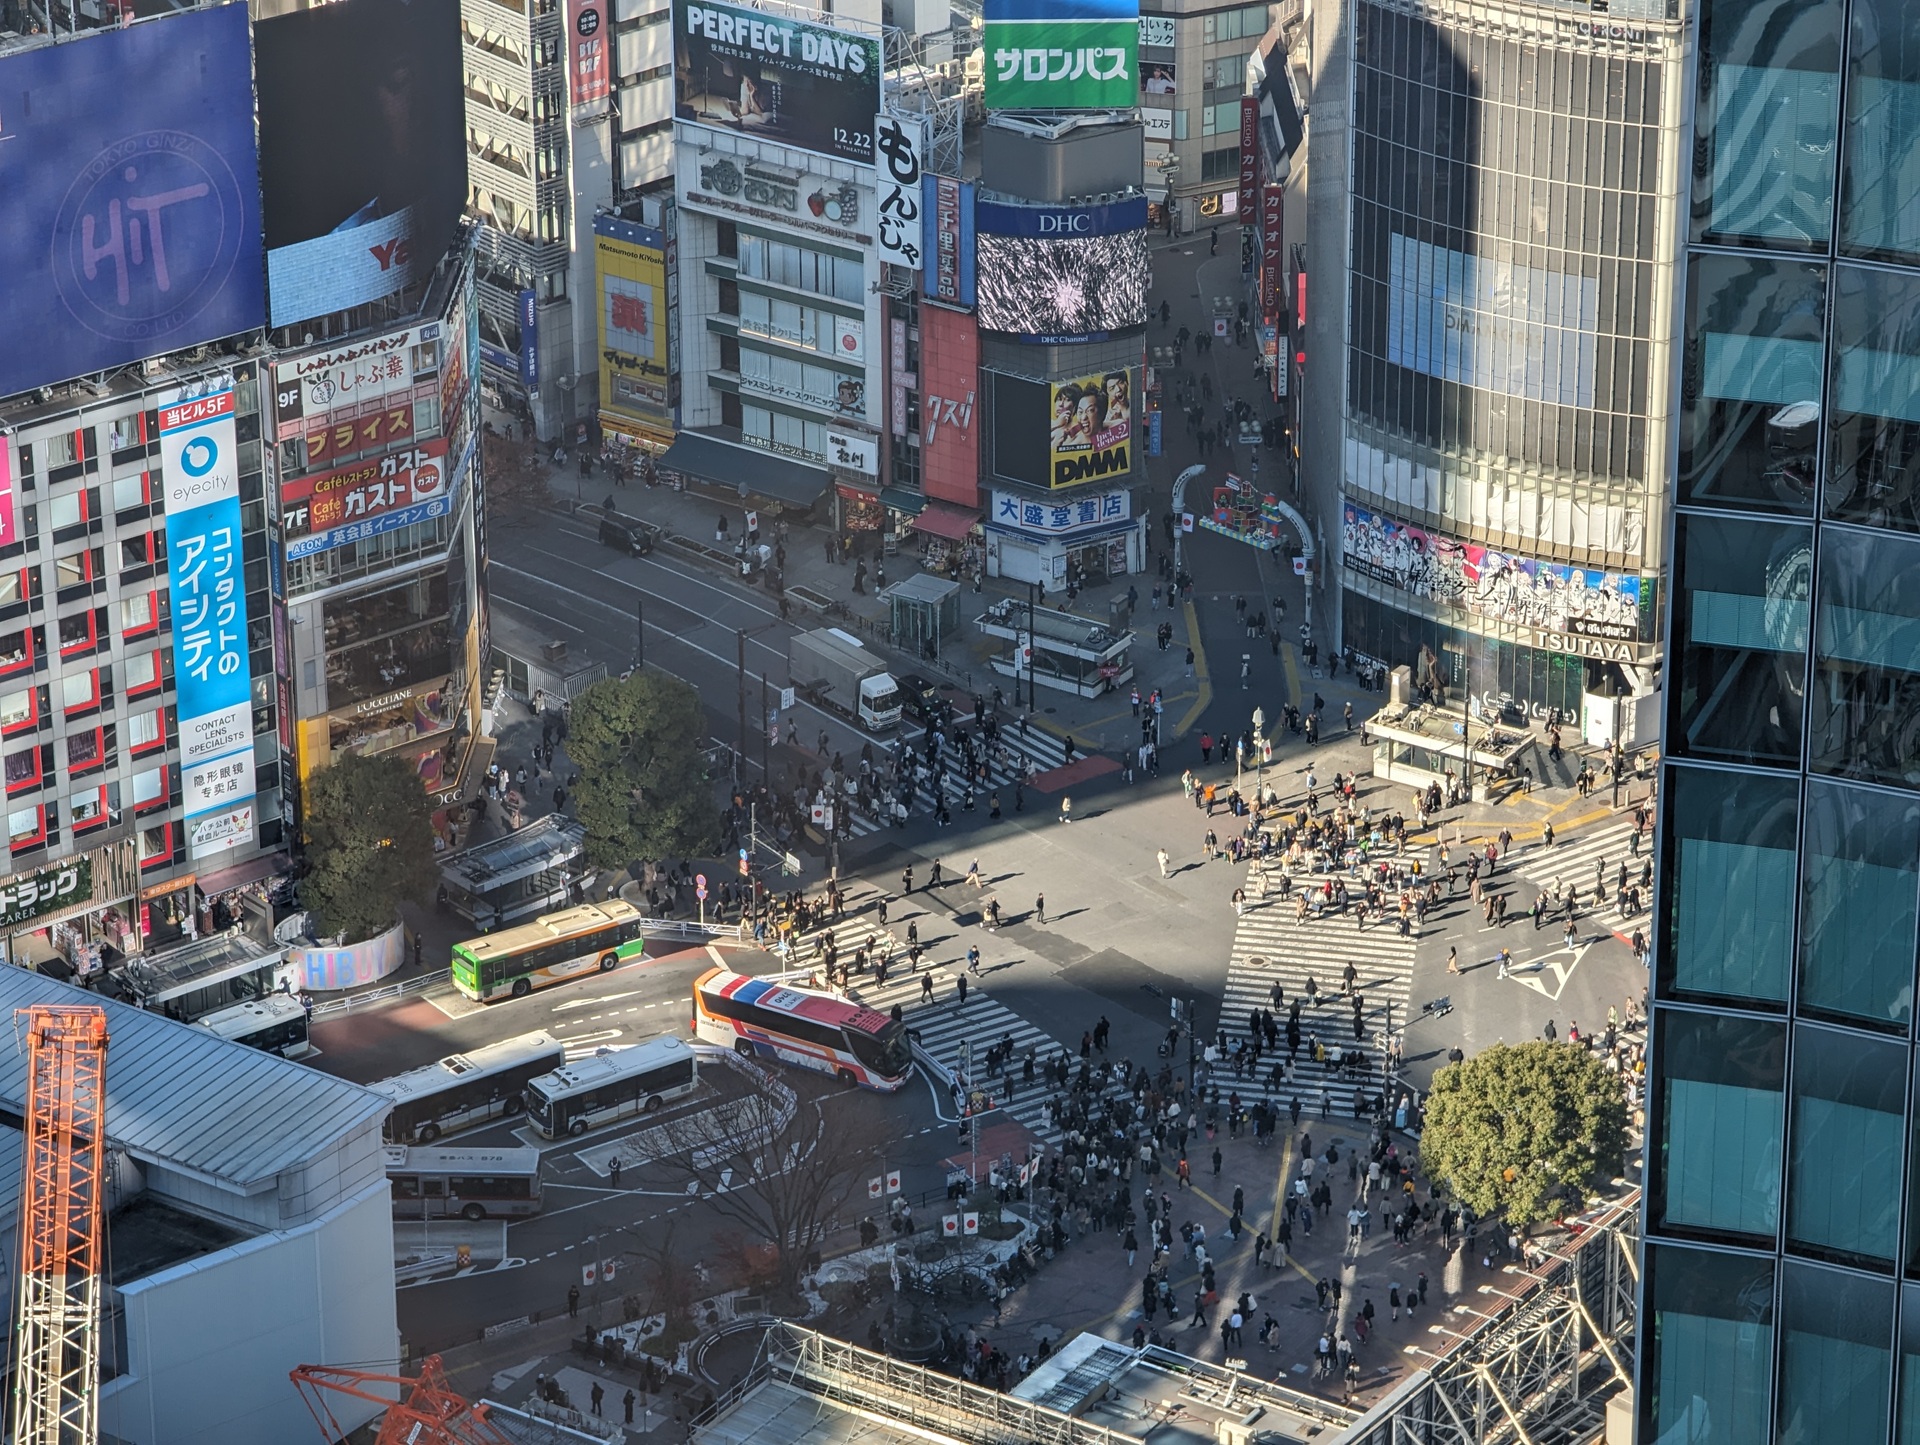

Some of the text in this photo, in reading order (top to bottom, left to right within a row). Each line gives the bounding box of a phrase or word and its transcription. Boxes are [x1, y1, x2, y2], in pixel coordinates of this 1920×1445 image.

[687, 5, 866, 73] PERFECT DAYS
[994, 47, 1128, 82] サロンパス
[834, 127, 871, 148] 12.22
[843, 145, 871, 156] THEATERS
[83, 134, 198, 184] TOKYO GINZA
[878, 120, 920, 267] もんじゃ
[1241, 154, 1255, 216] カラオケ
[1039, 214, 1090, 232] DHC
[1265, 196, 1279, 260] カラオケ
[599, 243, 638, 259] Matsumoto
[937, 182, 956, 298] 三千里薬品
[1041, 335, 1089, 344] DHC Channel
[340, 355, 404, 392] しゃぶ葉
[167, 398, 226, 426] 当ビル5F
[278, 390, 299, 408] 9F
[307, 409, 410, 458] プライス
[380, 449, 428, 479] ガスト
[1055, 447, 1128, 485] DMM
[173, 475, 229, 502] eyecity
[417, 474, 438, 487] ガスト
[313, 498, 341, 516] Café
[345, 480, 406, 518] ガスト
[429, 503, 441, 515] 6F
[1000, 494, 1122, 528] 大盛堂書店
[284, 507, 308, 530] 7F
[314, 510, 341, 524] レストラン
[292, 536, 324, 556] AEON
[176, 534, 216, 682] アイシティ
[212, 526, 242, 675] コンタクトの
[1536, 631, 1633, 661] TSUTAYA
[357, 689, 413, 713] L'OCCITANE
[195, 714, 235, 732] CONTACT
[205, 726, 227, 741] LENS
[189, 731, 245, 755] SPECIALISTS
[193, 762, 245, 789] 隐形眼镜
[201, 779, 239, 800] 专卖店
[197, 826, 234, 843] 献血ルーム
[200, 817, 231, 834] ハチ公前
[0, 868, 78, 914] ドラッグ
